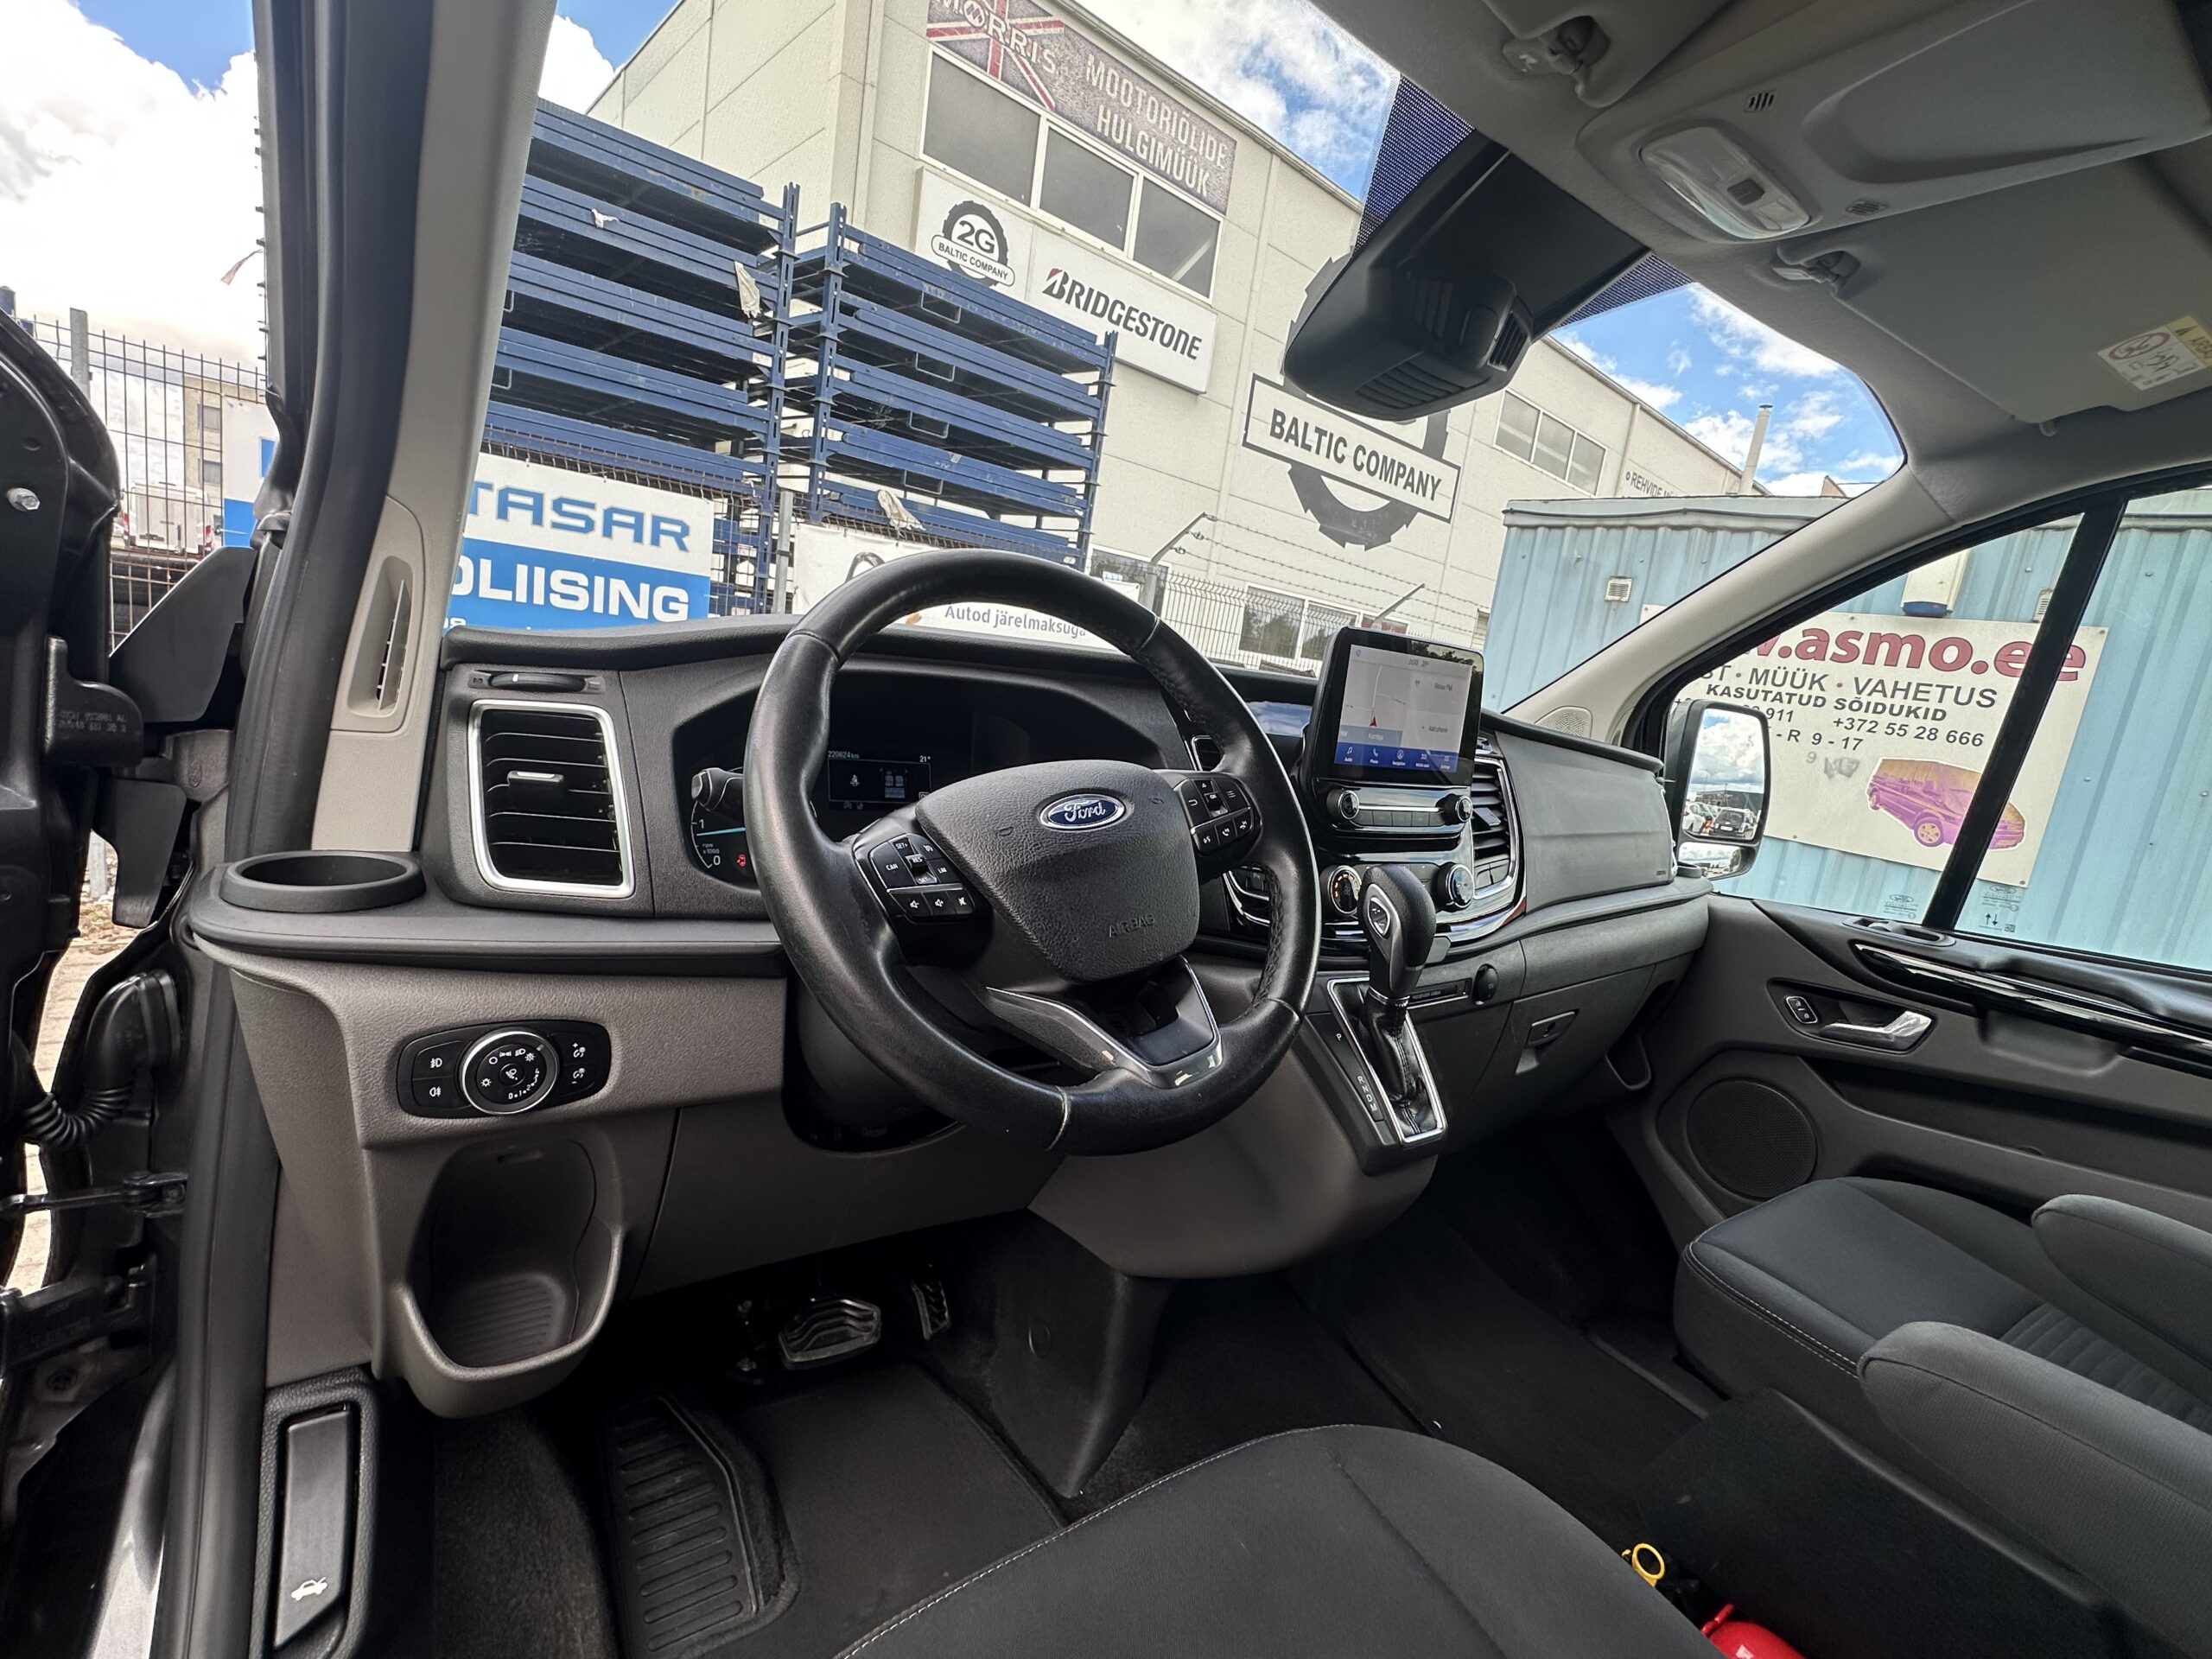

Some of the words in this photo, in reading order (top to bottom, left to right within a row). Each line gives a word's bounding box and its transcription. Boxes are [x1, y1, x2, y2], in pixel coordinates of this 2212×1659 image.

[1086, 54, 1228, 169] MOOTORIÕLIDE
[1096, 105, 1210, 198] HULGIMÜÜK
[957, 219, 995, 255] 2G
[938, 242, 969, 264] BALTIC
[969, 253, 1009, 281] COMPANY
[1042, 268, 1203, 360] BRIDGESTONE
[1269, 408, 1348, 464] BALTIC
[1352, 444, 1442, 501] COMPANY
[945, 606, 991, 624] Autod
[1706, 683, 1827, 708] KASUTATUD
[1834, 696, 1948, 722] SÕIDUKID
[1748, 666, 1830, 692] MÜÜK
[1853, 677, 1998, 709] VAHETUS
[1787, 728, 1802, 743] R
[1811, 732, 1823, 746] 9
[1840, 736, 1864, 752] 17
[1833, 716, 1879, 734] +372
[1885, 721, 1909, 737] 55
[1914, 726, 1939, 741] 28
[1945, 729, 1985, 747] 666
[1064, 800, 1106, 822] Ford
